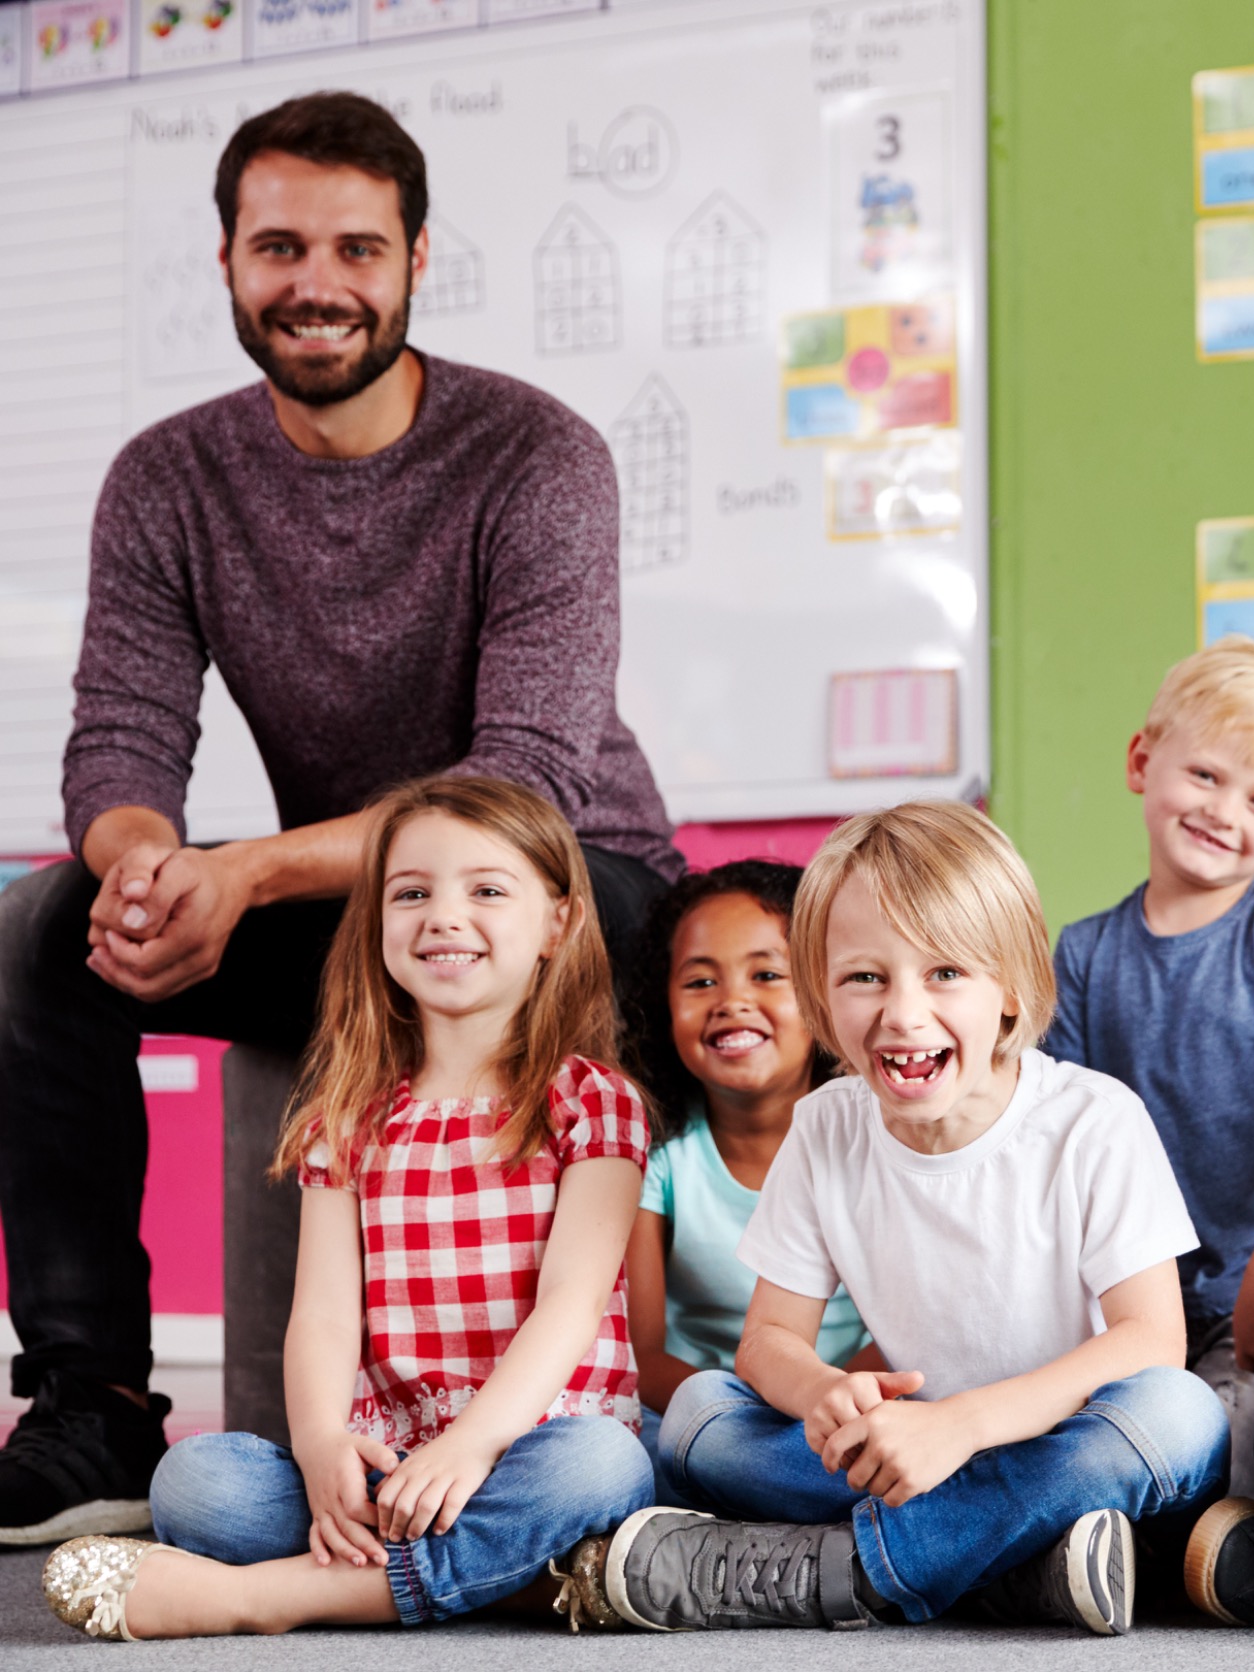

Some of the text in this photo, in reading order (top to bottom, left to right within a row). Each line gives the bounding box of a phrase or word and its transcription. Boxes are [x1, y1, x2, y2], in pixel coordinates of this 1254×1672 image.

[431, 79, 504, 118] flood
[565, 117, 660, 175] bad
[873, 112, 902, 163] 3
